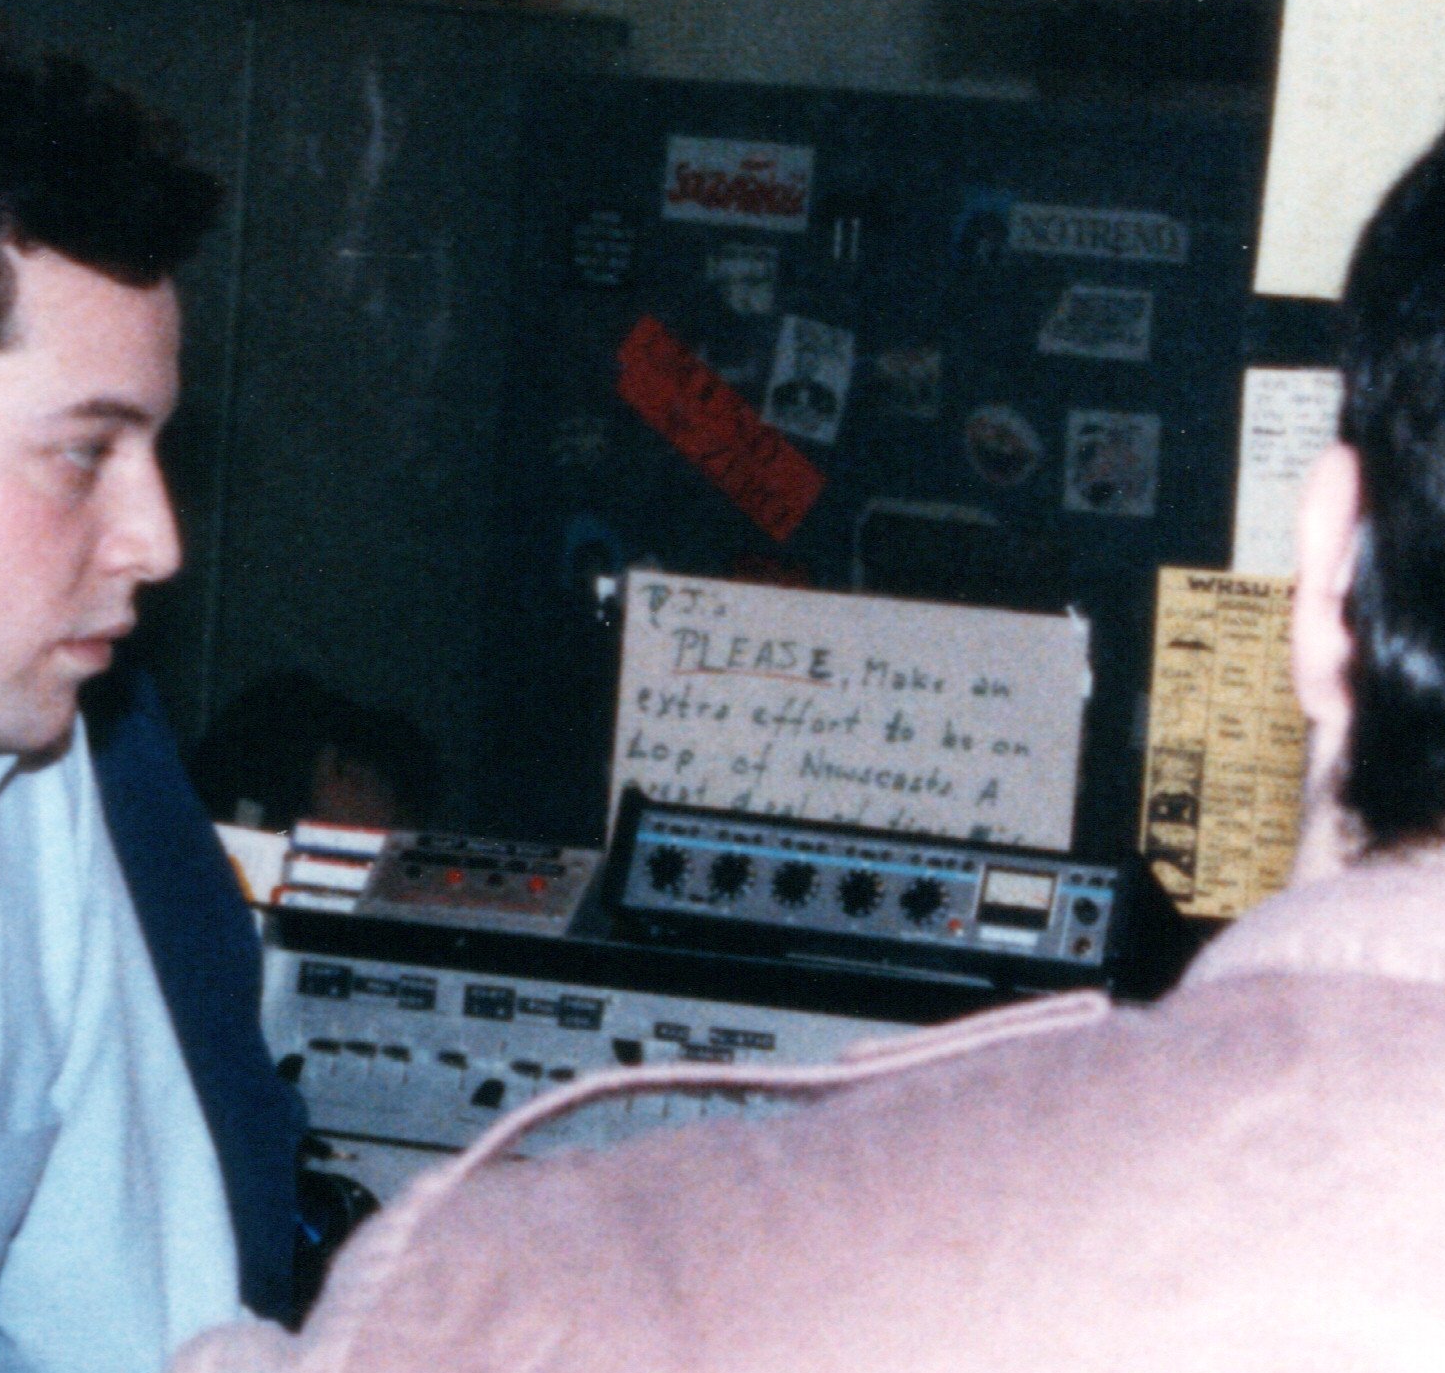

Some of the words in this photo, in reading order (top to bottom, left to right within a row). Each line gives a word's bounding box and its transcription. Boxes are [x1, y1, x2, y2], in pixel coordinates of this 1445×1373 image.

[861, 655, 949, 695] Make
[634, 683, 730, 723] extra
[750, 695, 862, 737] effort
[625, 726, 696, 774] top
[730, 740, 772, 786] of
[976, 776, 1001, 807] A
